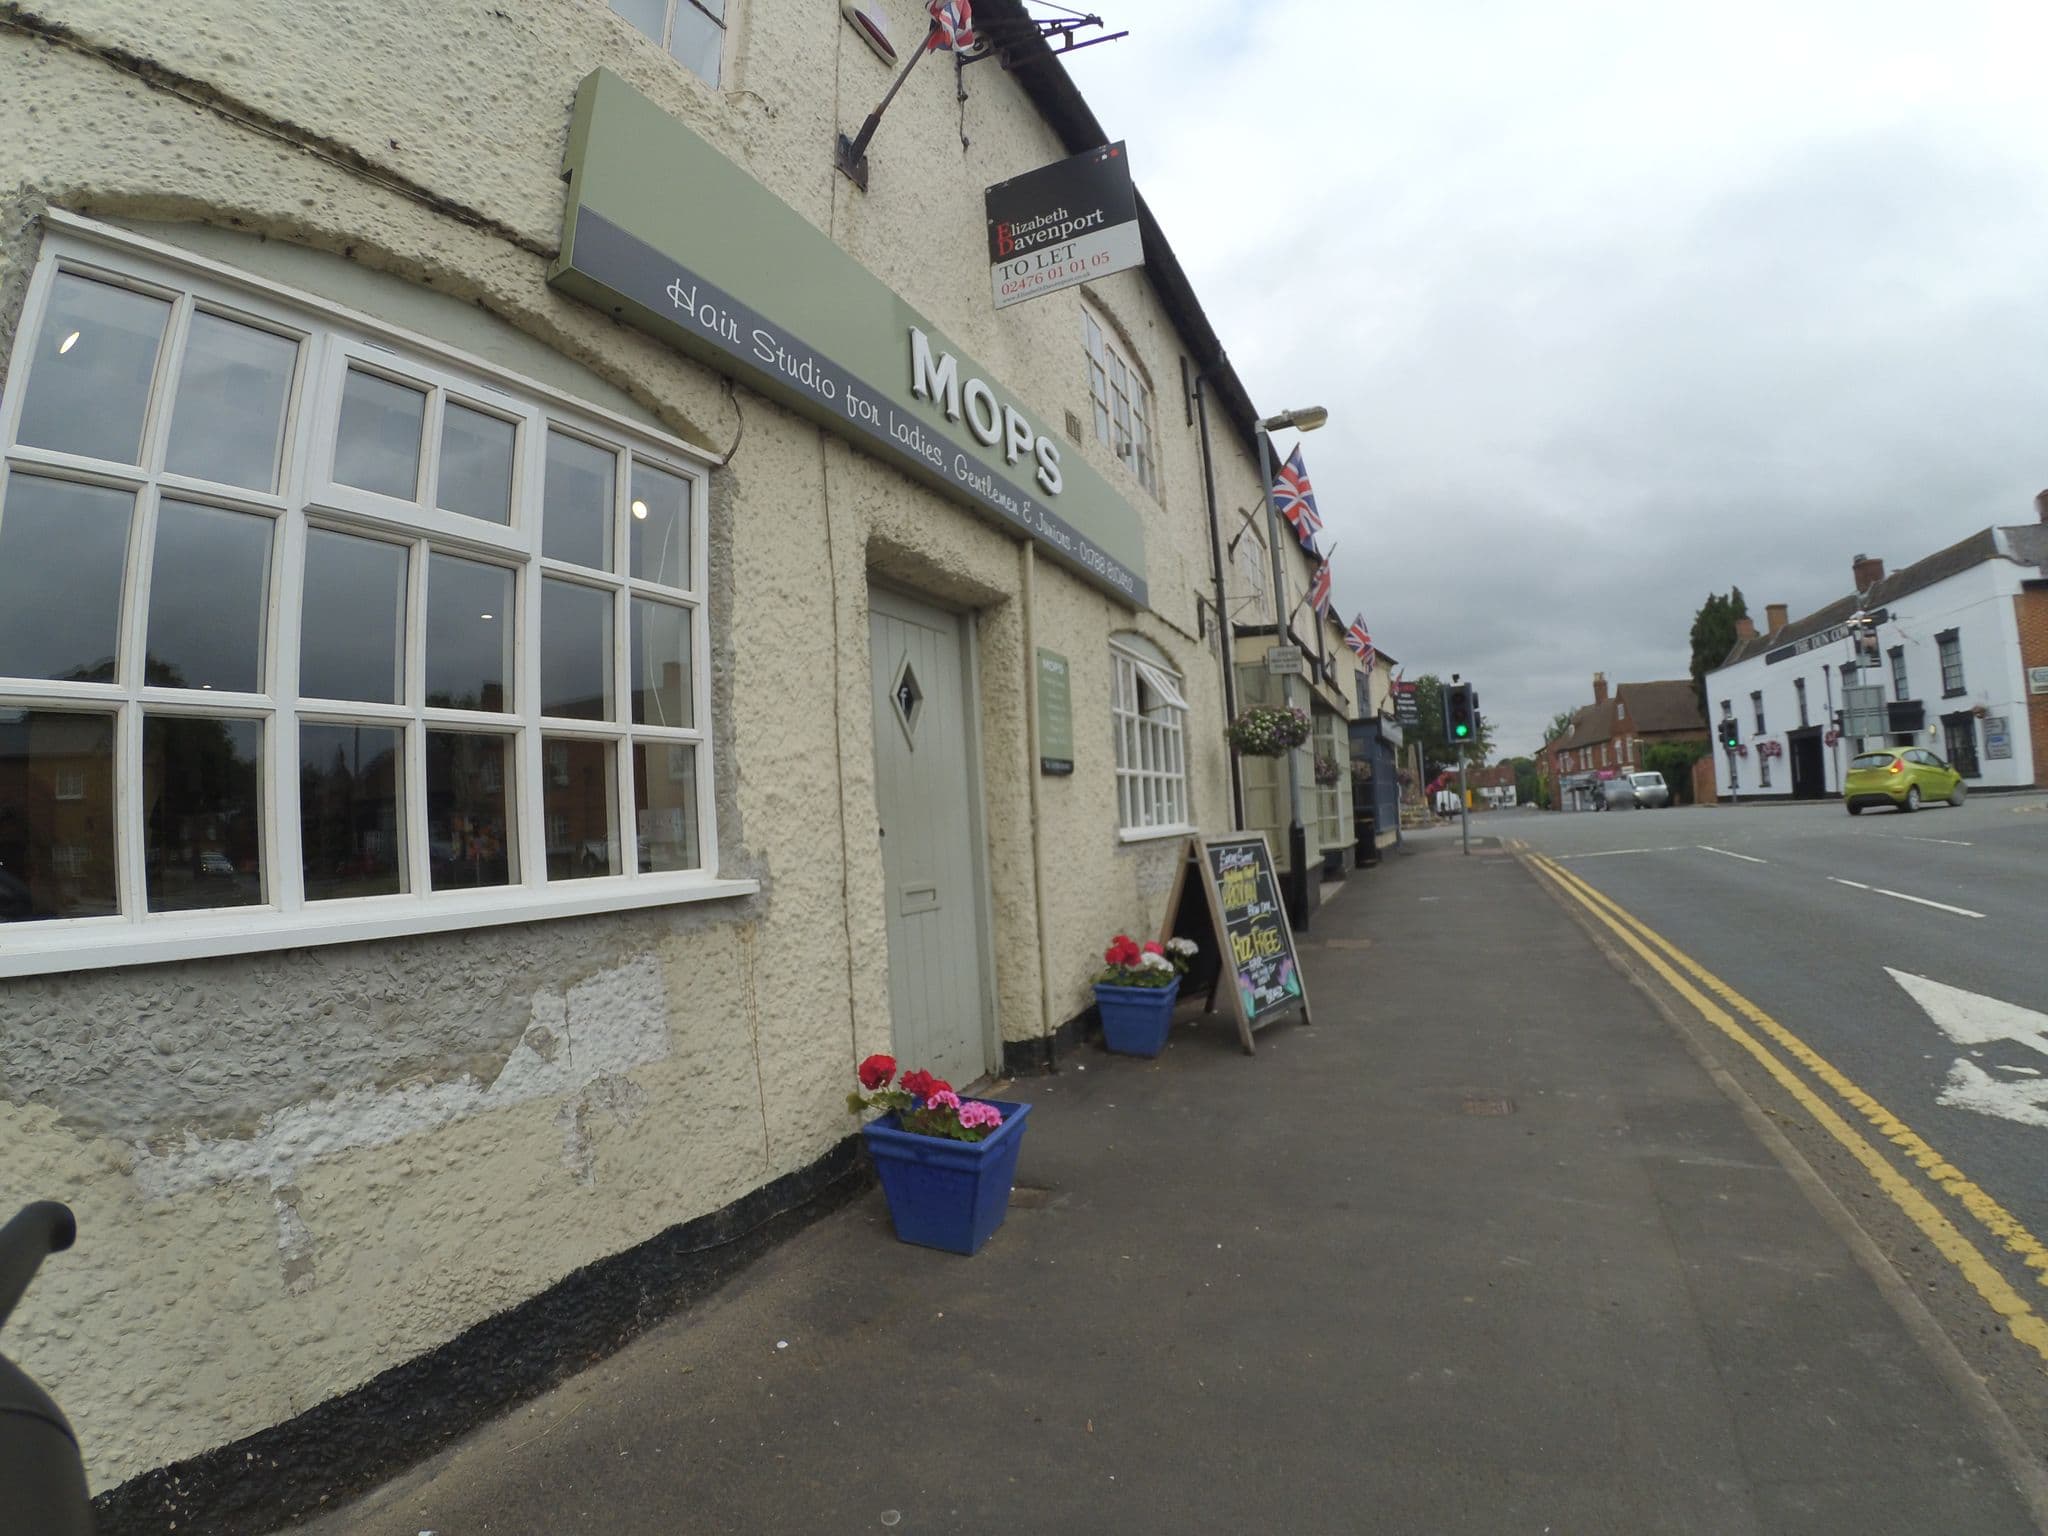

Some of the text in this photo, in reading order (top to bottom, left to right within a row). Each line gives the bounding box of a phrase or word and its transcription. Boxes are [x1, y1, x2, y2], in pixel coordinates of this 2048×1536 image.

[997, 207, 1069, 240] Elizabeth
[998, 208, 1104, 256] Davenport
[1000, 243, 1078, 281] TO LET
[1001, 272, 1044, 296] 02476
[1047, 265, 1064, 280] 01
[1069, 259, 1086, 274] 01
[1091, 251, 1110, 266] 05
[666, 278, 741, 344] Hair
[752, 329, 836, 399] Studio
[846, 385, 881, 427] for
[889, 410, 948, 473] Ladies,
[954, 453, 1020, 516] Gentlemen
[1035, 512, 1071, 551] Juniors
[909, 325, 1063, 496] MOPS
